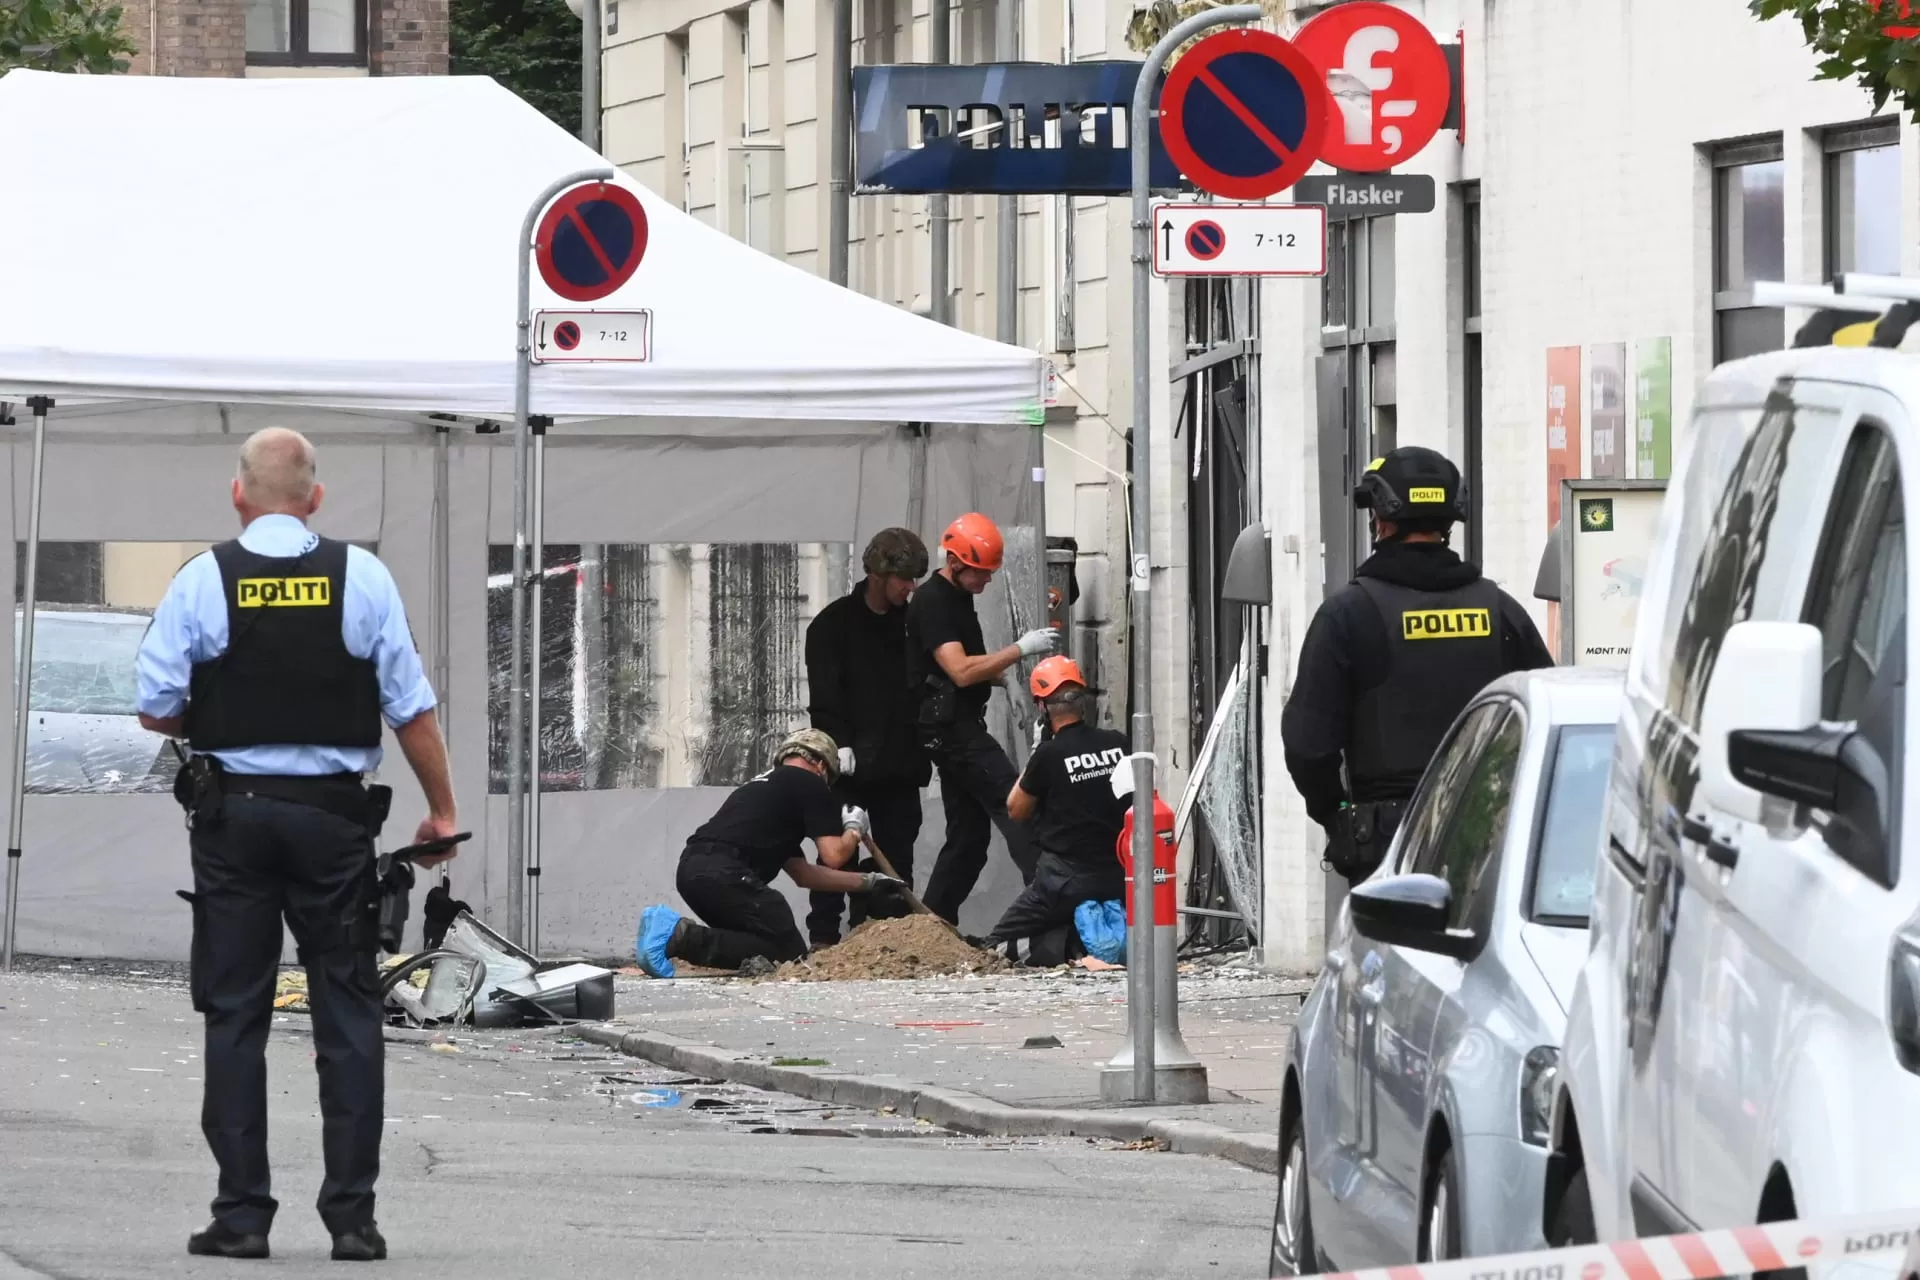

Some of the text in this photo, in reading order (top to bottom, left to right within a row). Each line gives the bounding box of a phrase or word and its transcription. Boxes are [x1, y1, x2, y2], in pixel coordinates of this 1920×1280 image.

[906, 102, 1128, 150] POLITI
[1327, 184, 1404, 205] Flasker
[1412, 491, 1443, 499] POLITI
[240, 582, 328, 603] POLITI
[1405, 612, 1489, 635] POLITI
